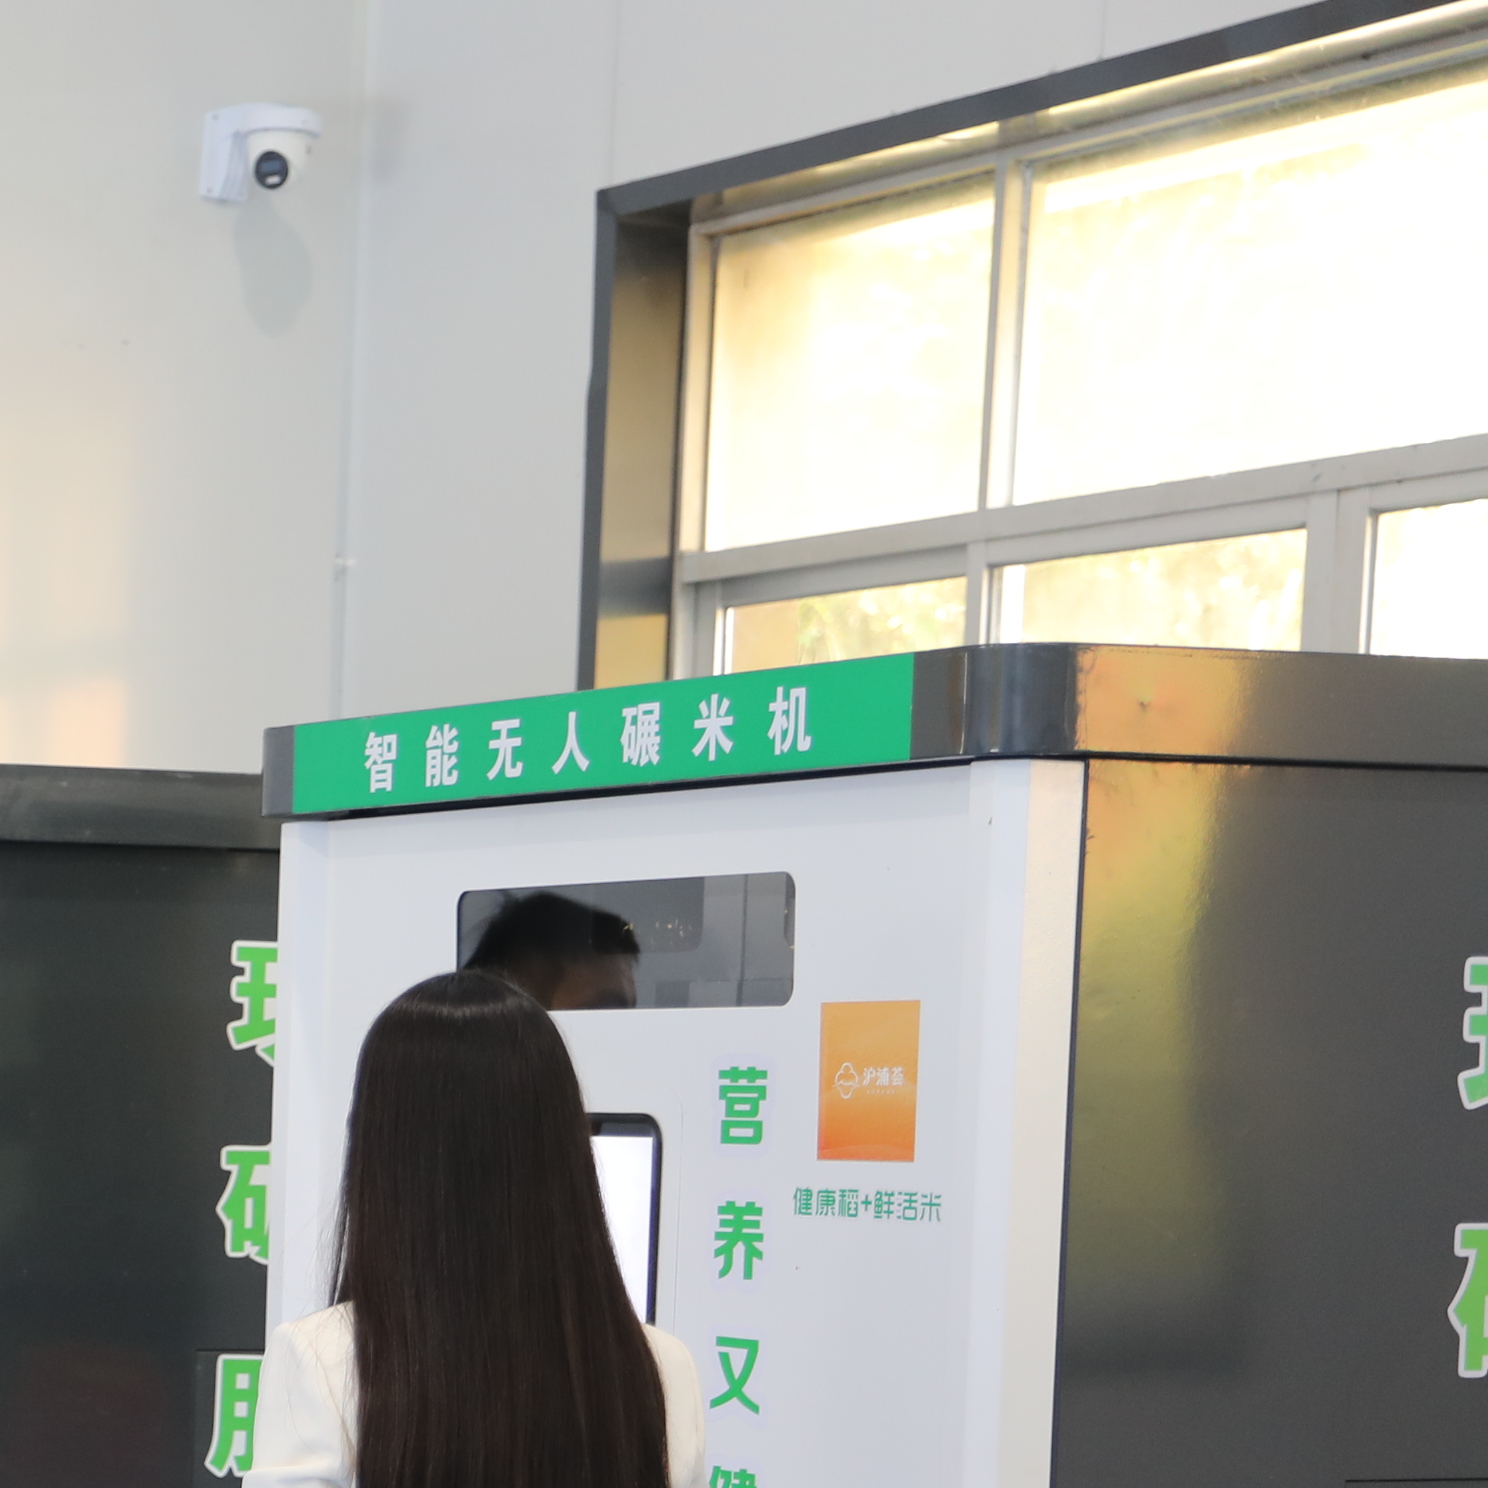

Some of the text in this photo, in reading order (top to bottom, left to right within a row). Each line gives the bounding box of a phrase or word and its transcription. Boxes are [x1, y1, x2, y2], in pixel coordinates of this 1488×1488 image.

[363, 686, 813, 793] 智能无人碾米机
[862, 1066, 904, 1086] 沪浦荟
[792, 1187, 941, 1222] 健康稻+鲜活米
